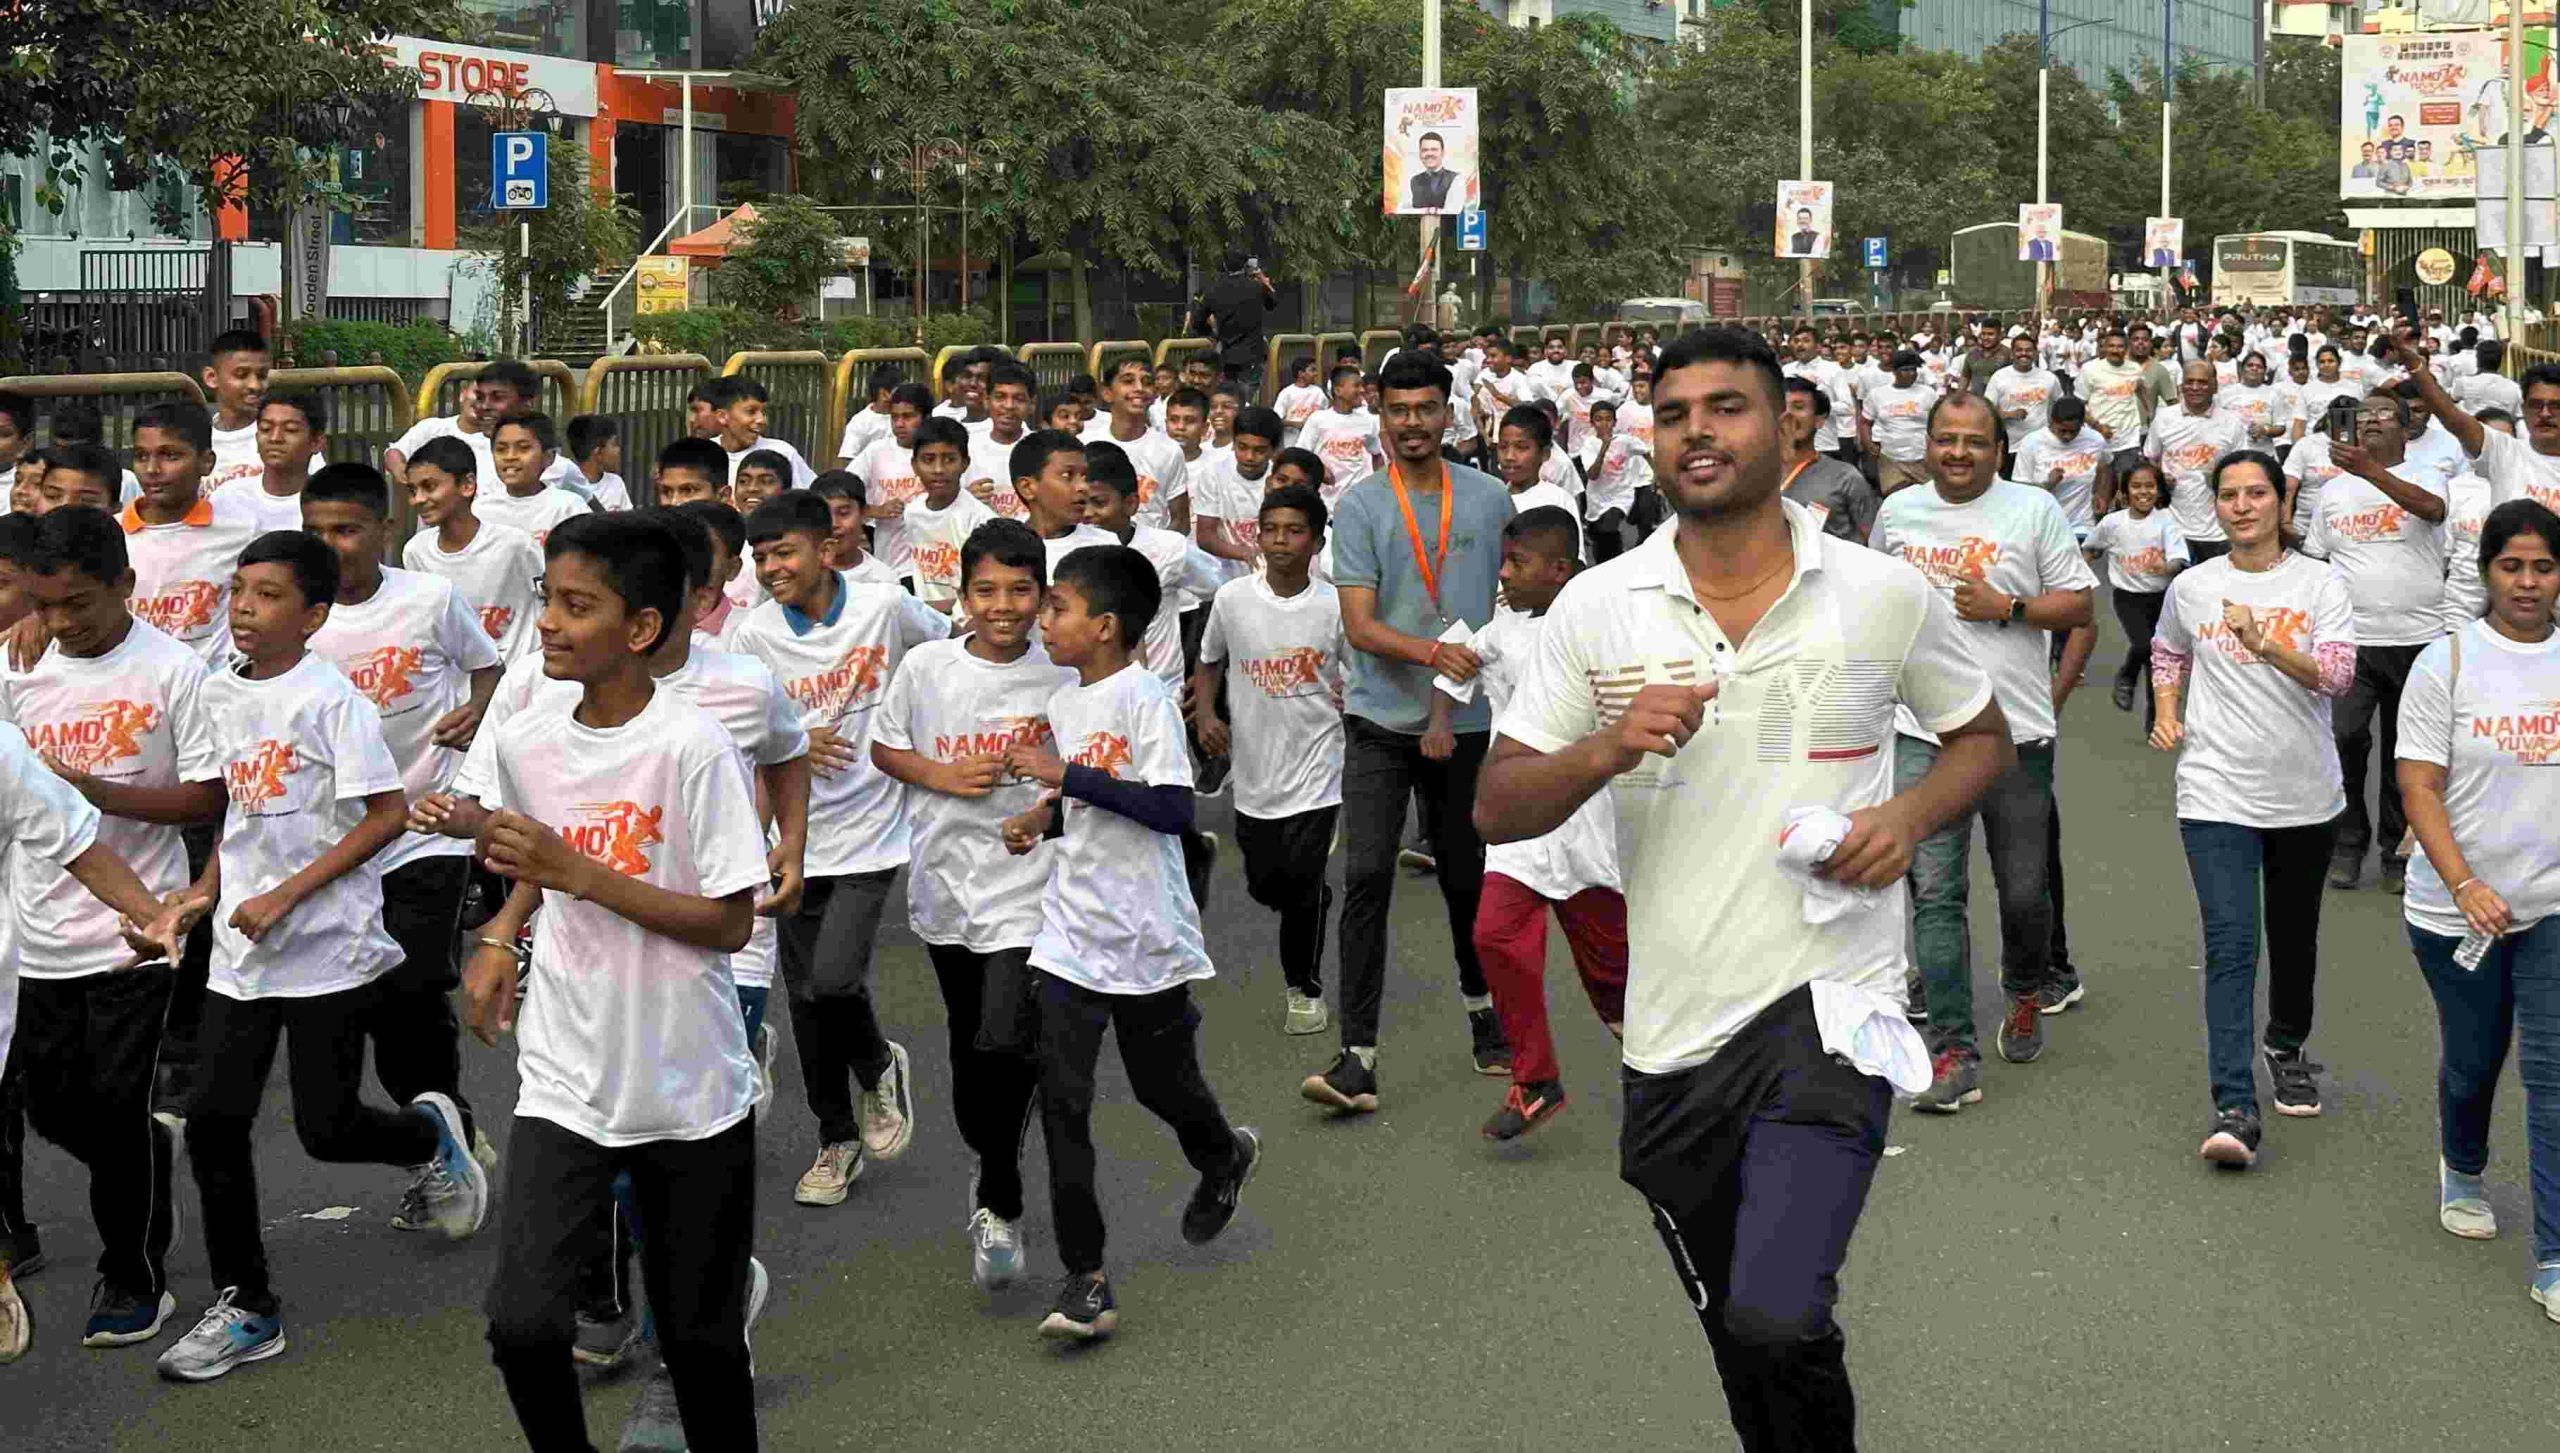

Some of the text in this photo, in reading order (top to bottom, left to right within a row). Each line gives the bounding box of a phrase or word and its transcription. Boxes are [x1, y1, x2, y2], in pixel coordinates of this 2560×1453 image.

[418, 51, 529, 98] STORE
[2400, 71, 2440, 82] NAMO
[1403, 103, 1442, 113] NAMO
[507, 137, 533, 175] P
[1465, 214, 1478, 232] P
[306, 214, 322, 261] Street
[1870, 240, 1880, 255] P
[2331, 514, 2377, 529] NAMO
[1904, 546, 1960, 564] NAMO
[1240, 659, 1295, 675] NAMO
[783, 668, 850, 699] NAMO
[21, 720, 102, 749] NAMO
[2473, 715, 2556, 737] NAMO
[935, 733, 1013, 757] NAMO
[2497, 736, 2546, 750] YUVA
[563, 826, 607, 855] MO
